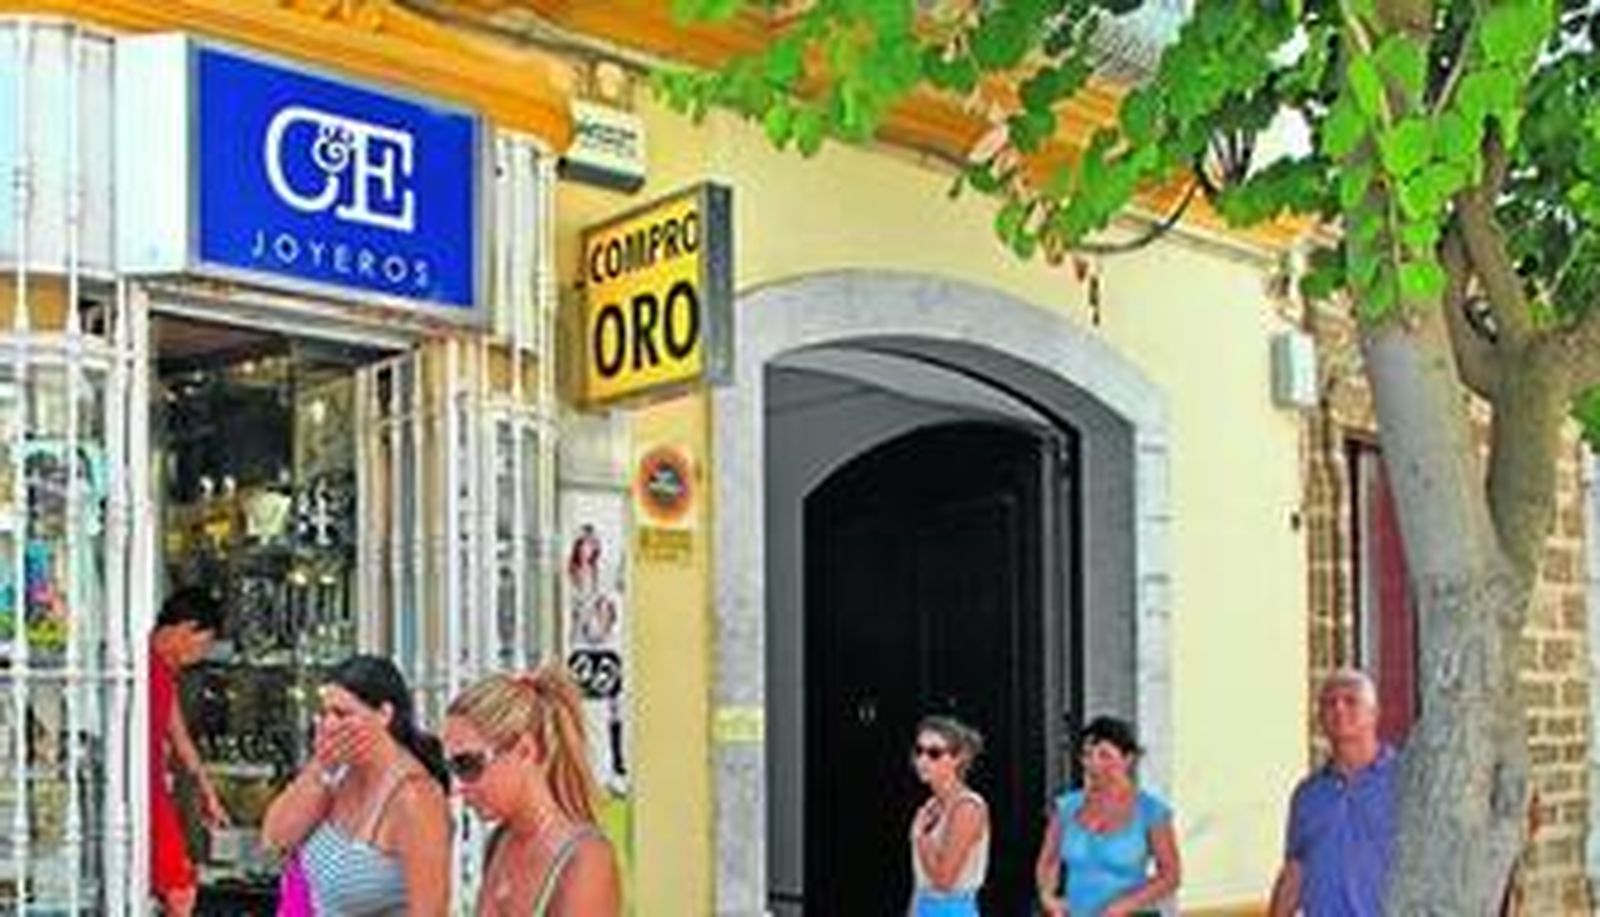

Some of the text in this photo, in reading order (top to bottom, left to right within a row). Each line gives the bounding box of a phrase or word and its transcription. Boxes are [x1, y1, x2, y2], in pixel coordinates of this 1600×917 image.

[264, 106, 414, 232] C&E
[252, 230, 429, 288] JOYEROS
[590, 210, 699, 283] COMPRO
[594, 281, 700, 378] ORO
